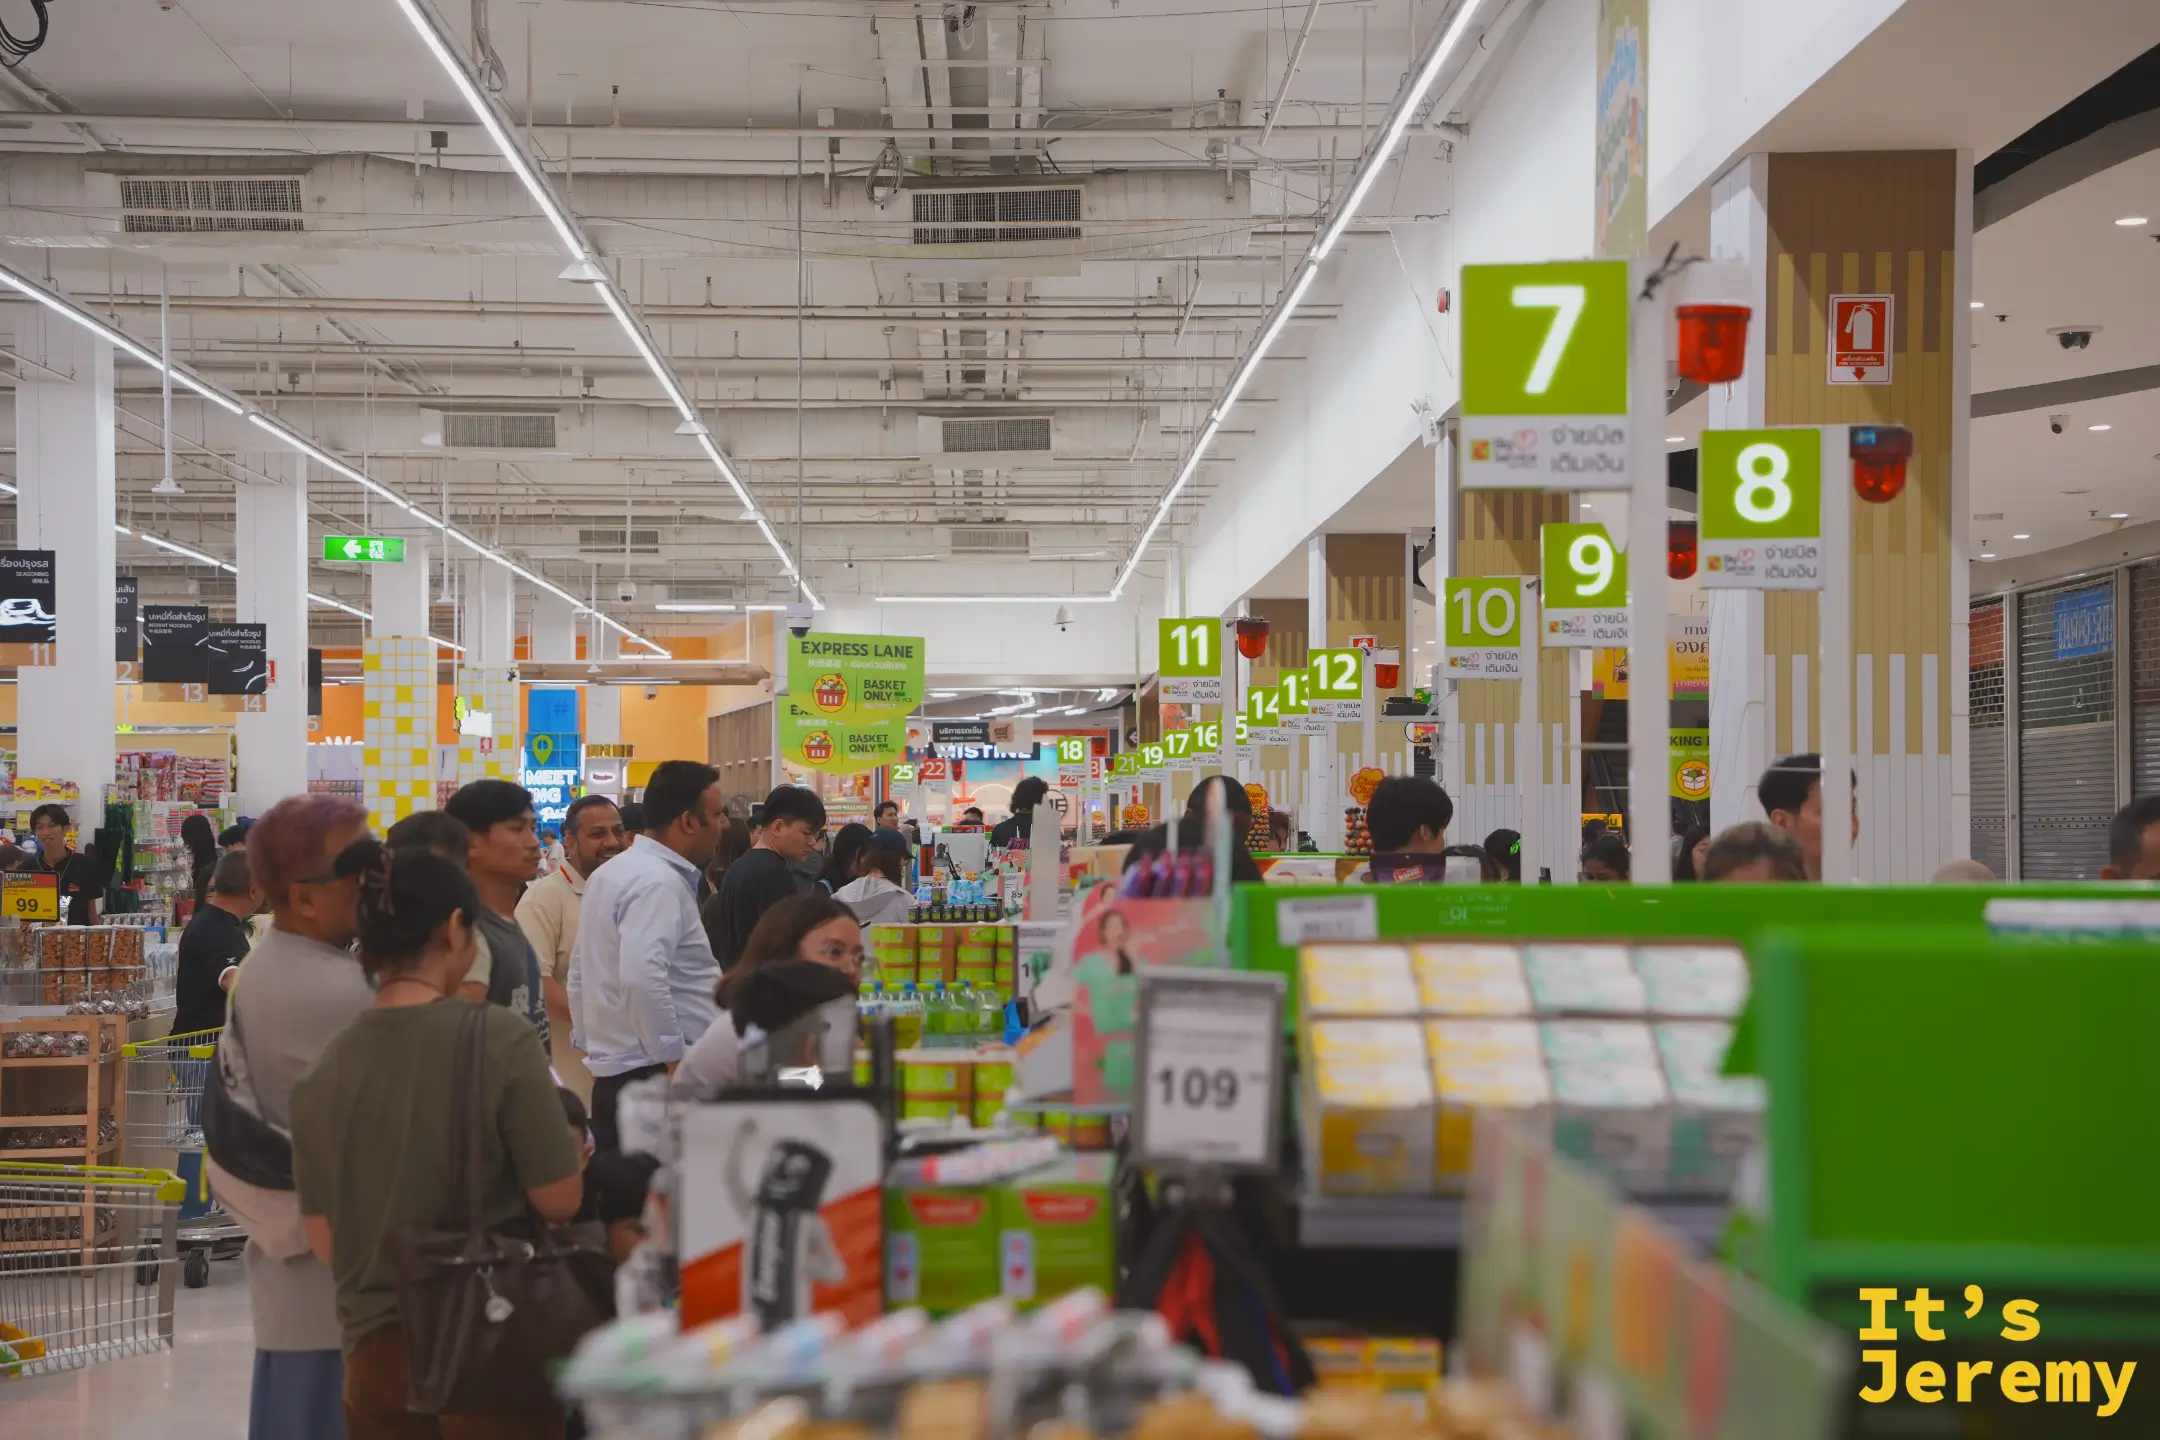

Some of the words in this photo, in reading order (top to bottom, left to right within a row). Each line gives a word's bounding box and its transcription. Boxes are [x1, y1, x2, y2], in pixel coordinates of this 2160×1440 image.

[1511, 285, 1585, 394] 7
[1734, 442, 1793, 523] 8
[1764, 544, 1818, 560] จ่ายบิล
[1569, 534, 1615, 597] 9
[1764, 563, 1818, 579] เติมเงิน
[1453, 587, 1516, 636] 10
[801, 641, 868, 657] EXPRESS
[874, 645, 913, 658] LANE
[1170, 624, 1208, 666] 11
[28, 643, 50, 666] 11
[1484, 650, 1519, 661] จ่ายบิล
[1313, 653, 1358, 690] 12
[1485, 663, 1519, 673] เติมเงิน
[864, 679, 906, 690] BASKET
[1192, 679, 1220, 688] จ่ายบิล
[181, 683, 203, 702] 13
[864, 690, 892, 701] ONLY
[1192, 690, 1220, 699] เติมเงิน
[241, 694, 262, 712] 14
[849, 734, 888, 743] BASKET
[1165, 733, 1190, 754] 17
[1194, 725, 1218, 748] 16
[849, 744, 876, 753] ONLY
[1060, 740, 1084, 760] 18
[1142, 746, 1164, 765] 19
[925, 761, 944, 776] 22
[1118, 756, 1136, 772] 21
[525, 769, 577, 785] MEET
[894, 765, 913, 780] 25
[16, 898, 38, 912] 99
[1157, 1065, 1240, 1112] 109
